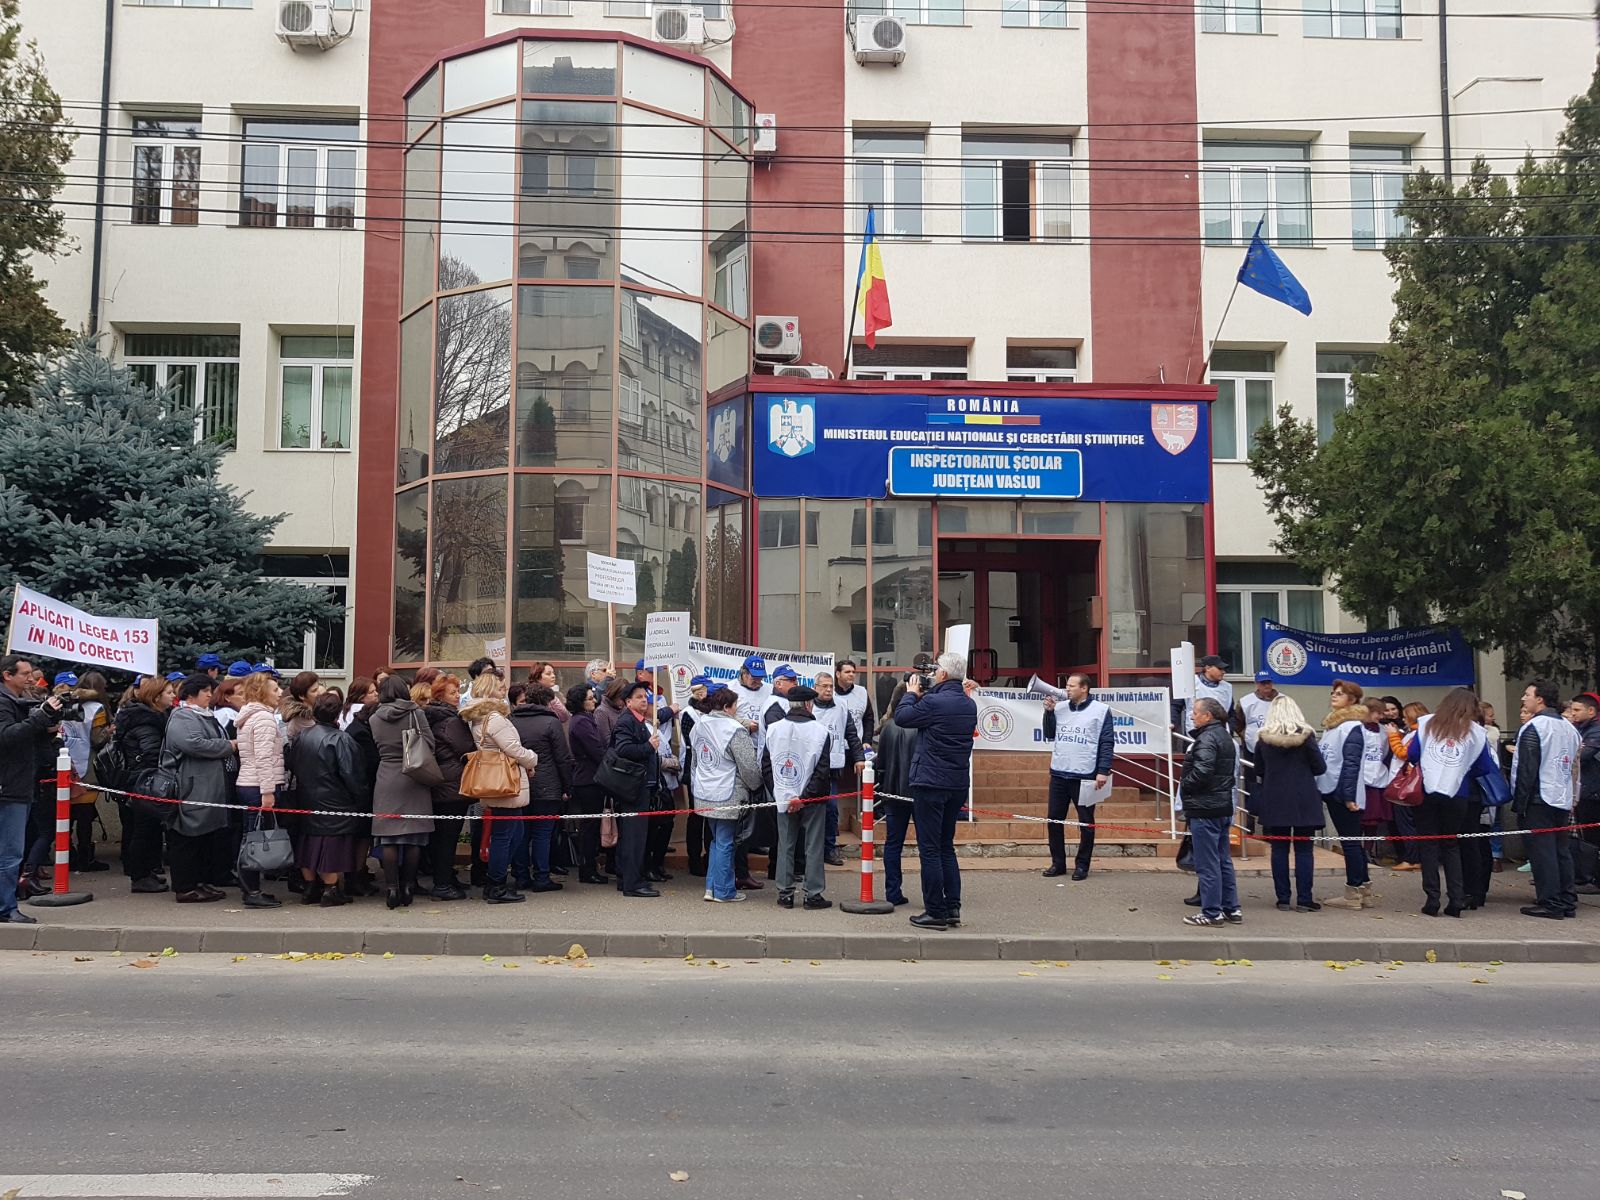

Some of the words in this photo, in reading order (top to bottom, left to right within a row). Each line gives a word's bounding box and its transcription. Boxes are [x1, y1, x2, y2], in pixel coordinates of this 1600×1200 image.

[947, 398, 1019, 413] ROMÂNIA
[824, 429, 887, 440] MINISTERUL
[1020, 432, 1082, 444] CERCETĂRII
[911, 453, 1010, 469] INSPECTORATUL
[996, 475, 1041, 489] VASLUI
[79, 620, 119, 642] LEGEA
[124, 630, 149, 644] 153
[1362, 636, 1389, 645] Libere
[1391, 633, 1404, 641] din
[27, 624, 45, 644] ÎN
[48, 632, 75, 652] MOD
[78, 641, 134, 664] CORECT!
[1305, 640, 1374, 660] Sindicatul
[707, 643, 755, 658] SINDICATELOR
[778, 653, 790, 662] DIN
[1101, 693, 1114, 702] DIN
[1056, 732, 1088, 744] Vaslui
[1113, 731, 1147, 744] ASLUI
